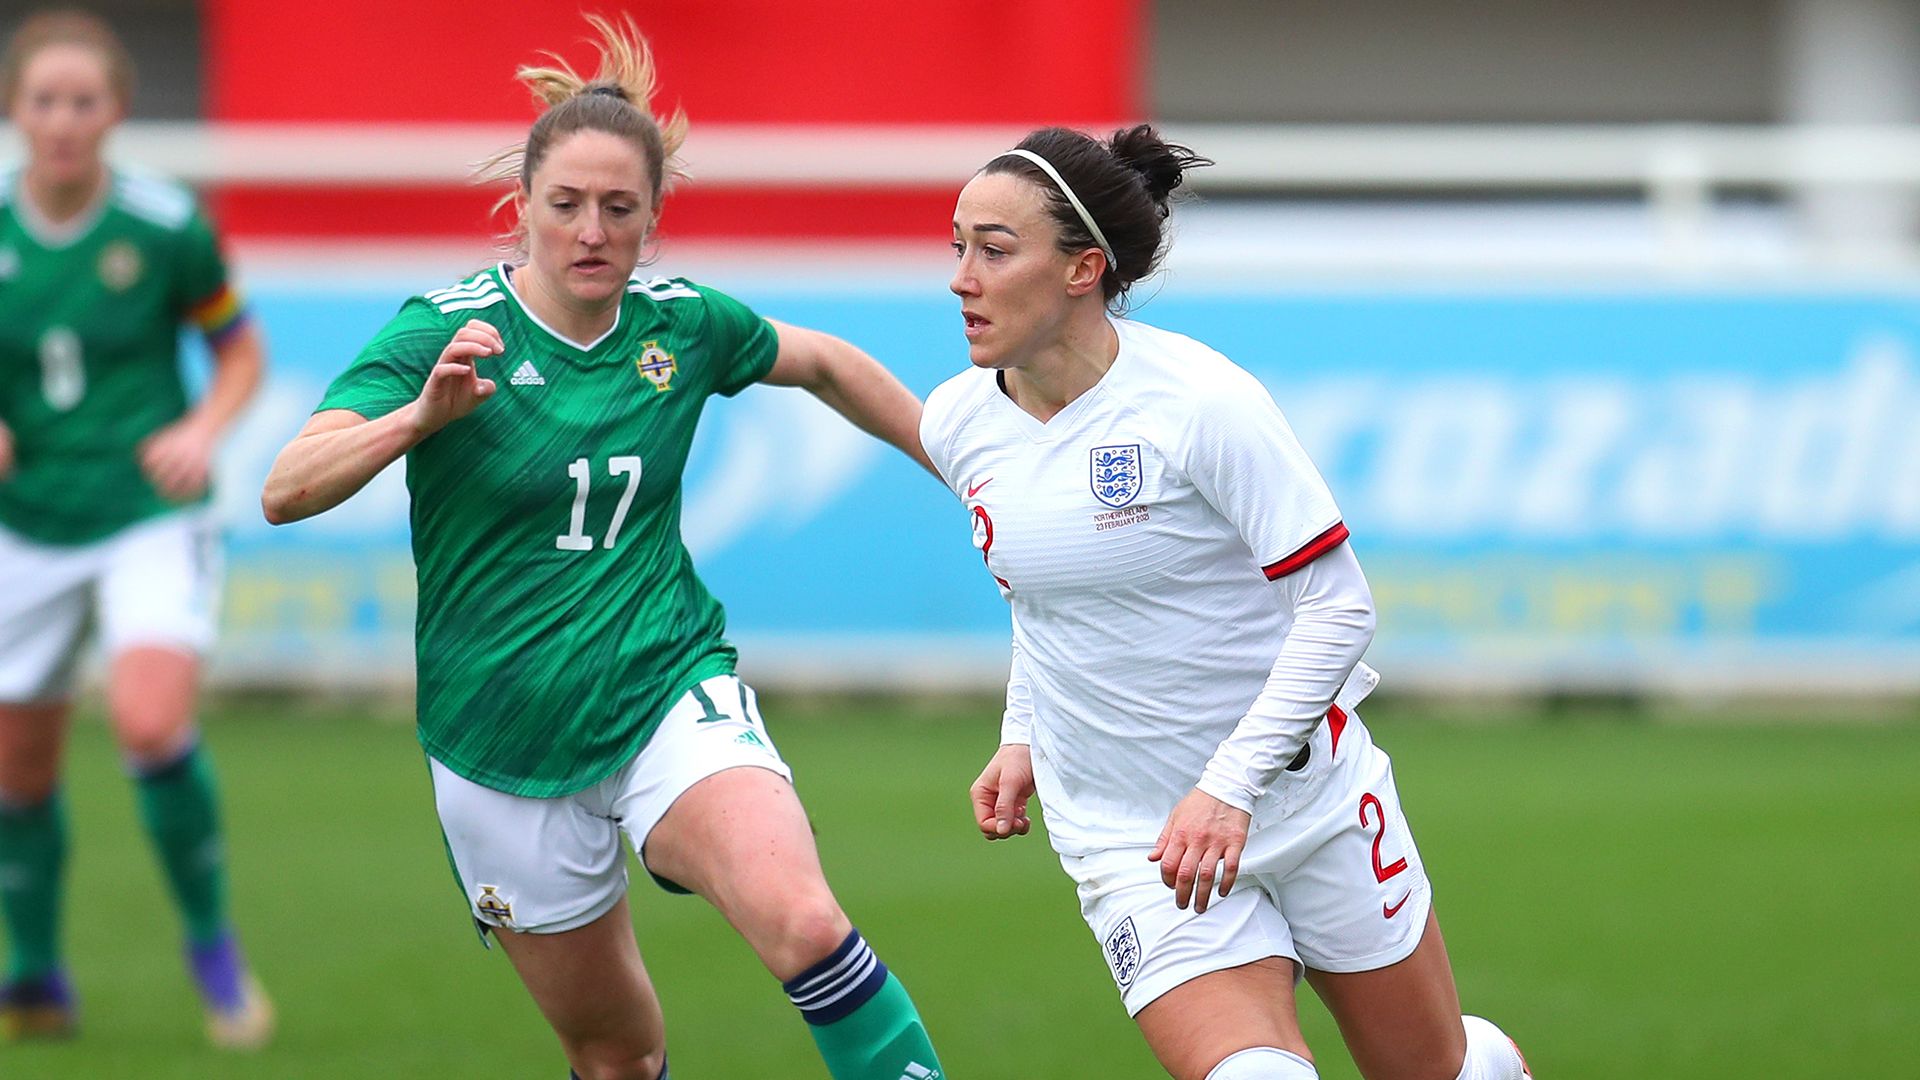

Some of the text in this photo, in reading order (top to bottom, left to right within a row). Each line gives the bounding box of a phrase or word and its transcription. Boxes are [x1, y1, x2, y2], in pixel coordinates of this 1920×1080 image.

[510, 377, 546, 386] adidas
[555, 455, 643, 551] 17
[1094, 505, 1147, 521] NORTHERN IRELAND
[1096, 523, 1104, 531] 23
[1105, 517, 1135, 529] FEBRUARY
[1359, 792, 1408, 884] 2
